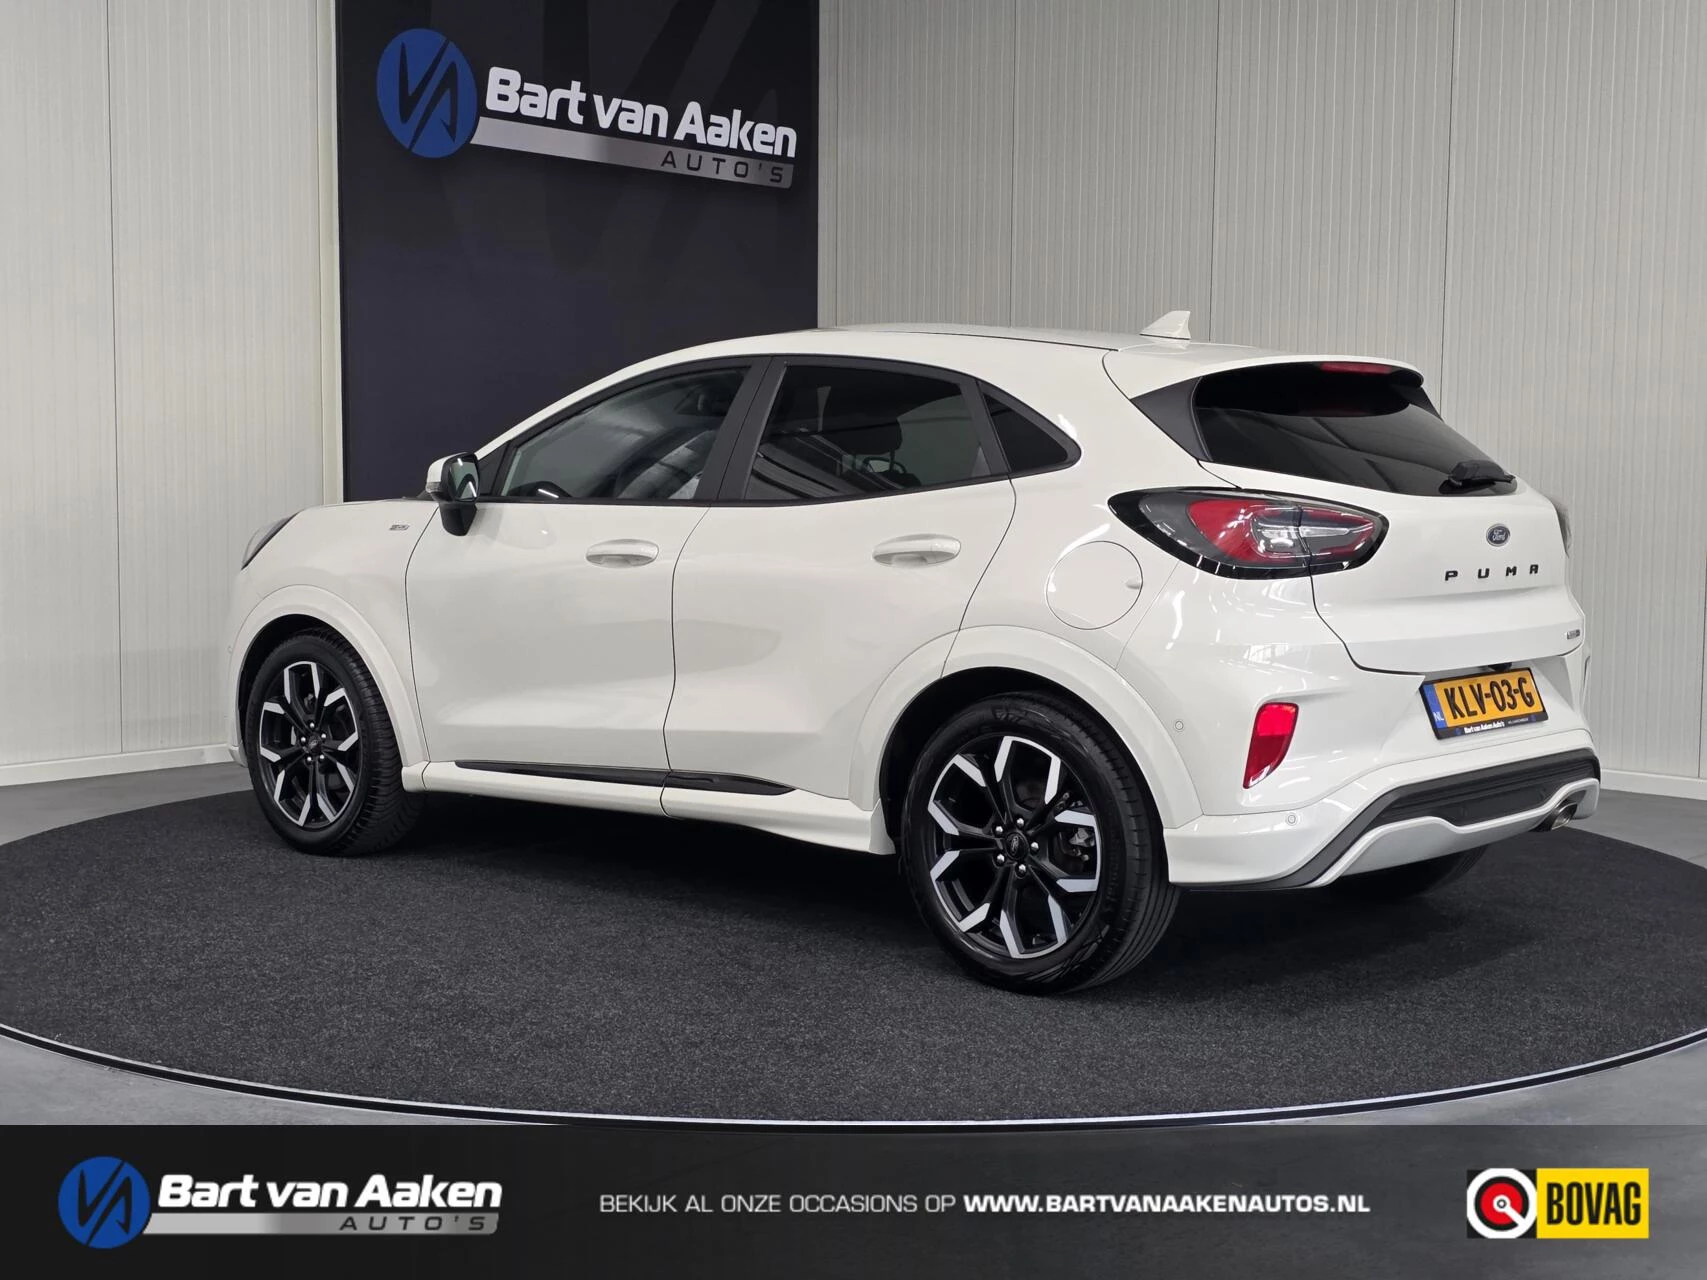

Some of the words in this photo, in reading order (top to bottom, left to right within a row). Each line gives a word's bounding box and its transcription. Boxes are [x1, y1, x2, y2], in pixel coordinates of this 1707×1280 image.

[485, 66, 587, 125] Bart
[593, 93, 669, 138] van
[673, 101, 798, 157] Aaken
[660, 150, 783, 184] AUTO'S
[1444, 564, 1539, 581] PUMA
[1443, 676, 1535, 720] KLV-03-G
[1433, 711, 1445, 721] NL
